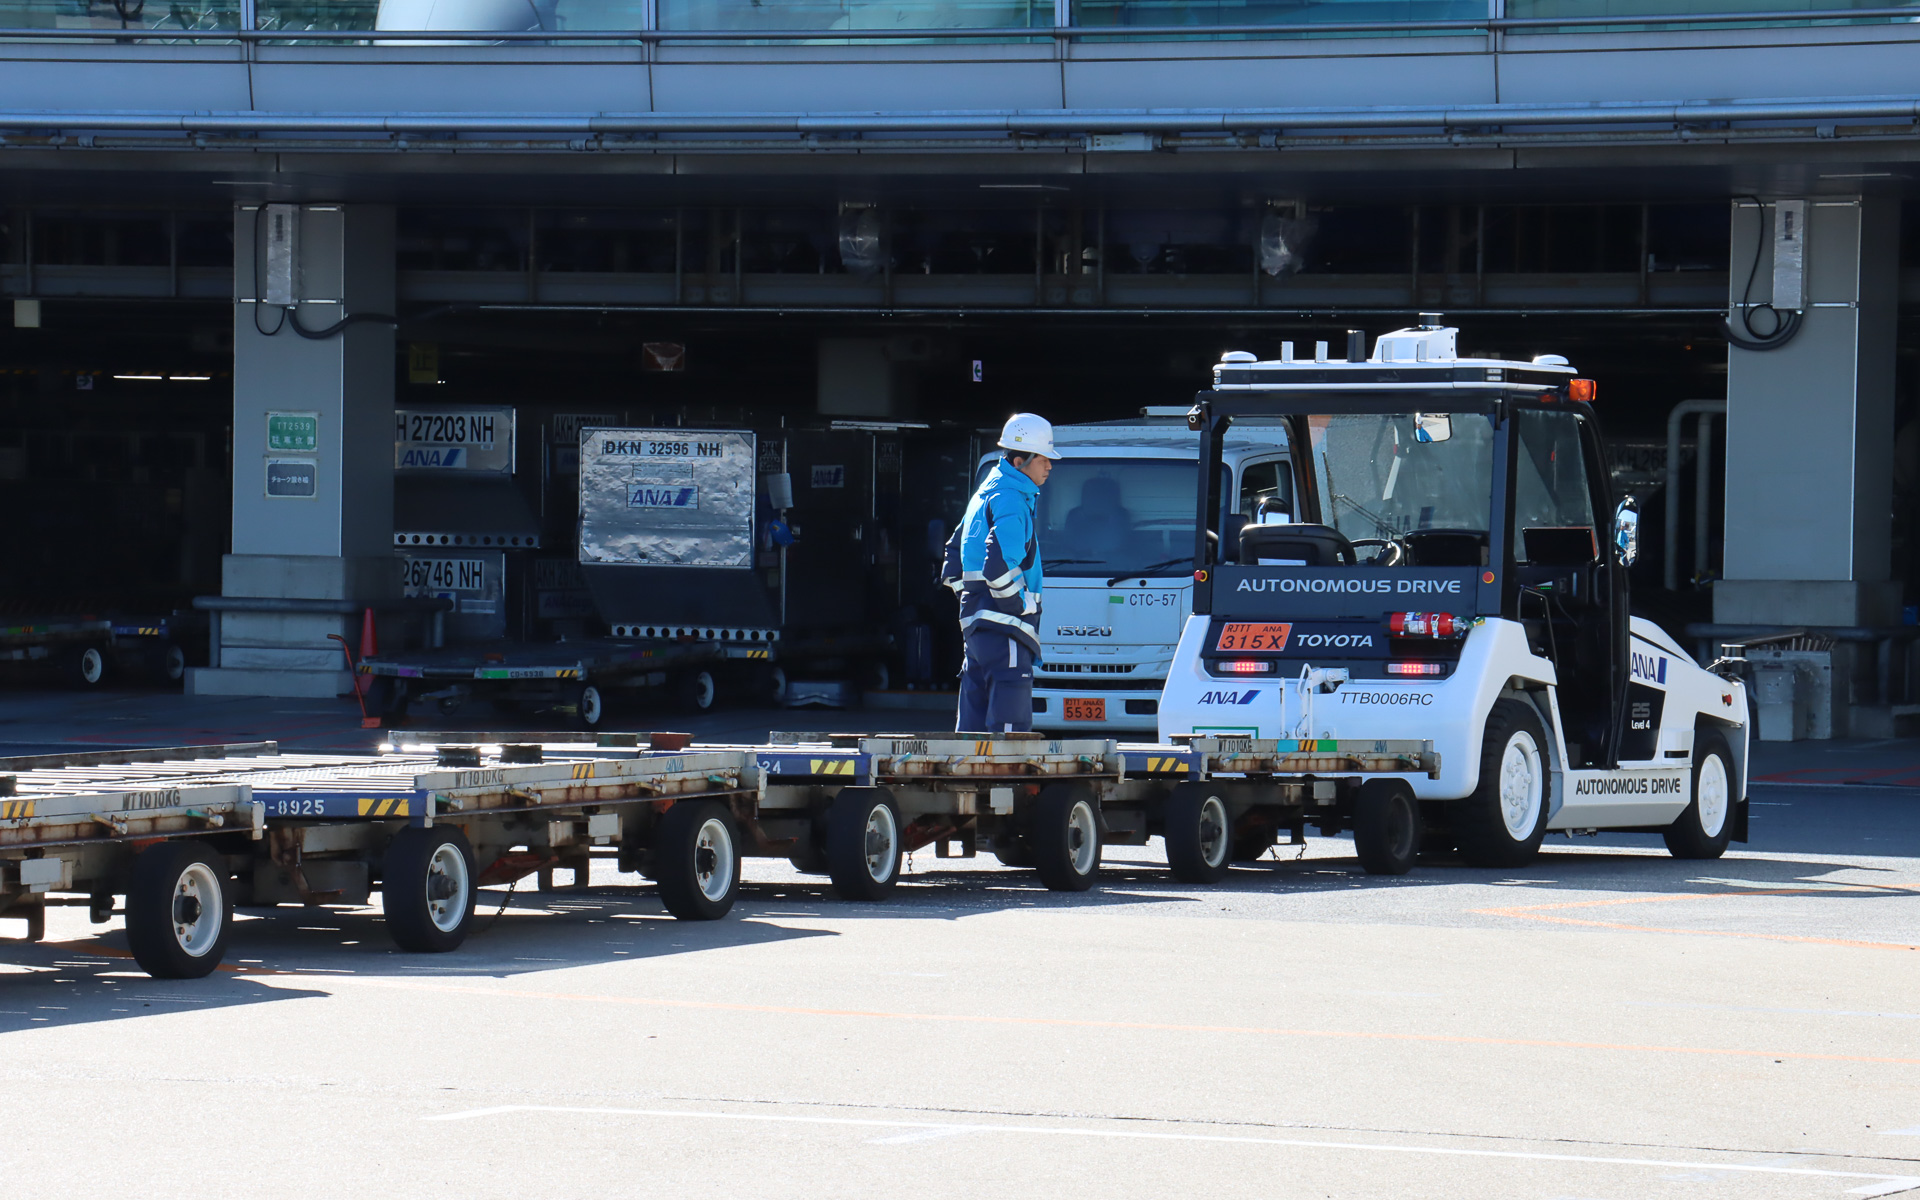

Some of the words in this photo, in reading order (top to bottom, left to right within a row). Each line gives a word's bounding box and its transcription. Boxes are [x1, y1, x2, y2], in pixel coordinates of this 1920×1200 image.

[277, 422, 310, 430] TT2539
[412, 416, 465, 442] 27203
[471, 417, 493, 441] NH
[555, 416, 573, 441] AKH
[605, 441, 641, 455] DKN
[649, 442, 688, 455] 32596
[697, 442, 719, 456] NH
[402, 451, 440, 466] ANA
[813, 470, 832, 485] ANA
[631, 489, 672, 506] ANA
[404, 561, 453, 587] 26746
[460, 562, 482, 588] NH
[1236, 578, 1391, 593] AUTONOMOUS
[1397, 580, 1461, 593] DRIVE
[1129, 594, 1177, 606] CTC-57
[1057, 626, 1112, 636] ISUZU
[1227, 624, 1251, 632] RJTT
[1222, 635, 1283, 649] 315X
[1297, 634, 1373, 647] TOYOTA
[1631, 652, 1656, 682] ANA
[1198, 691, 1238, 704] ANA
[1341, 692, 1434, 706] TTB0006RC
[1066, 707, 1102, 719] 5532
[1631, 720, 1644, 729] Level
[1645, 721, 1650, 729] 4
[757, 760, 781, 774] 24
[1576, 778, 1648, 795] AUTONOMOUS
[1652, 777, 1681, 793] DRIVE
